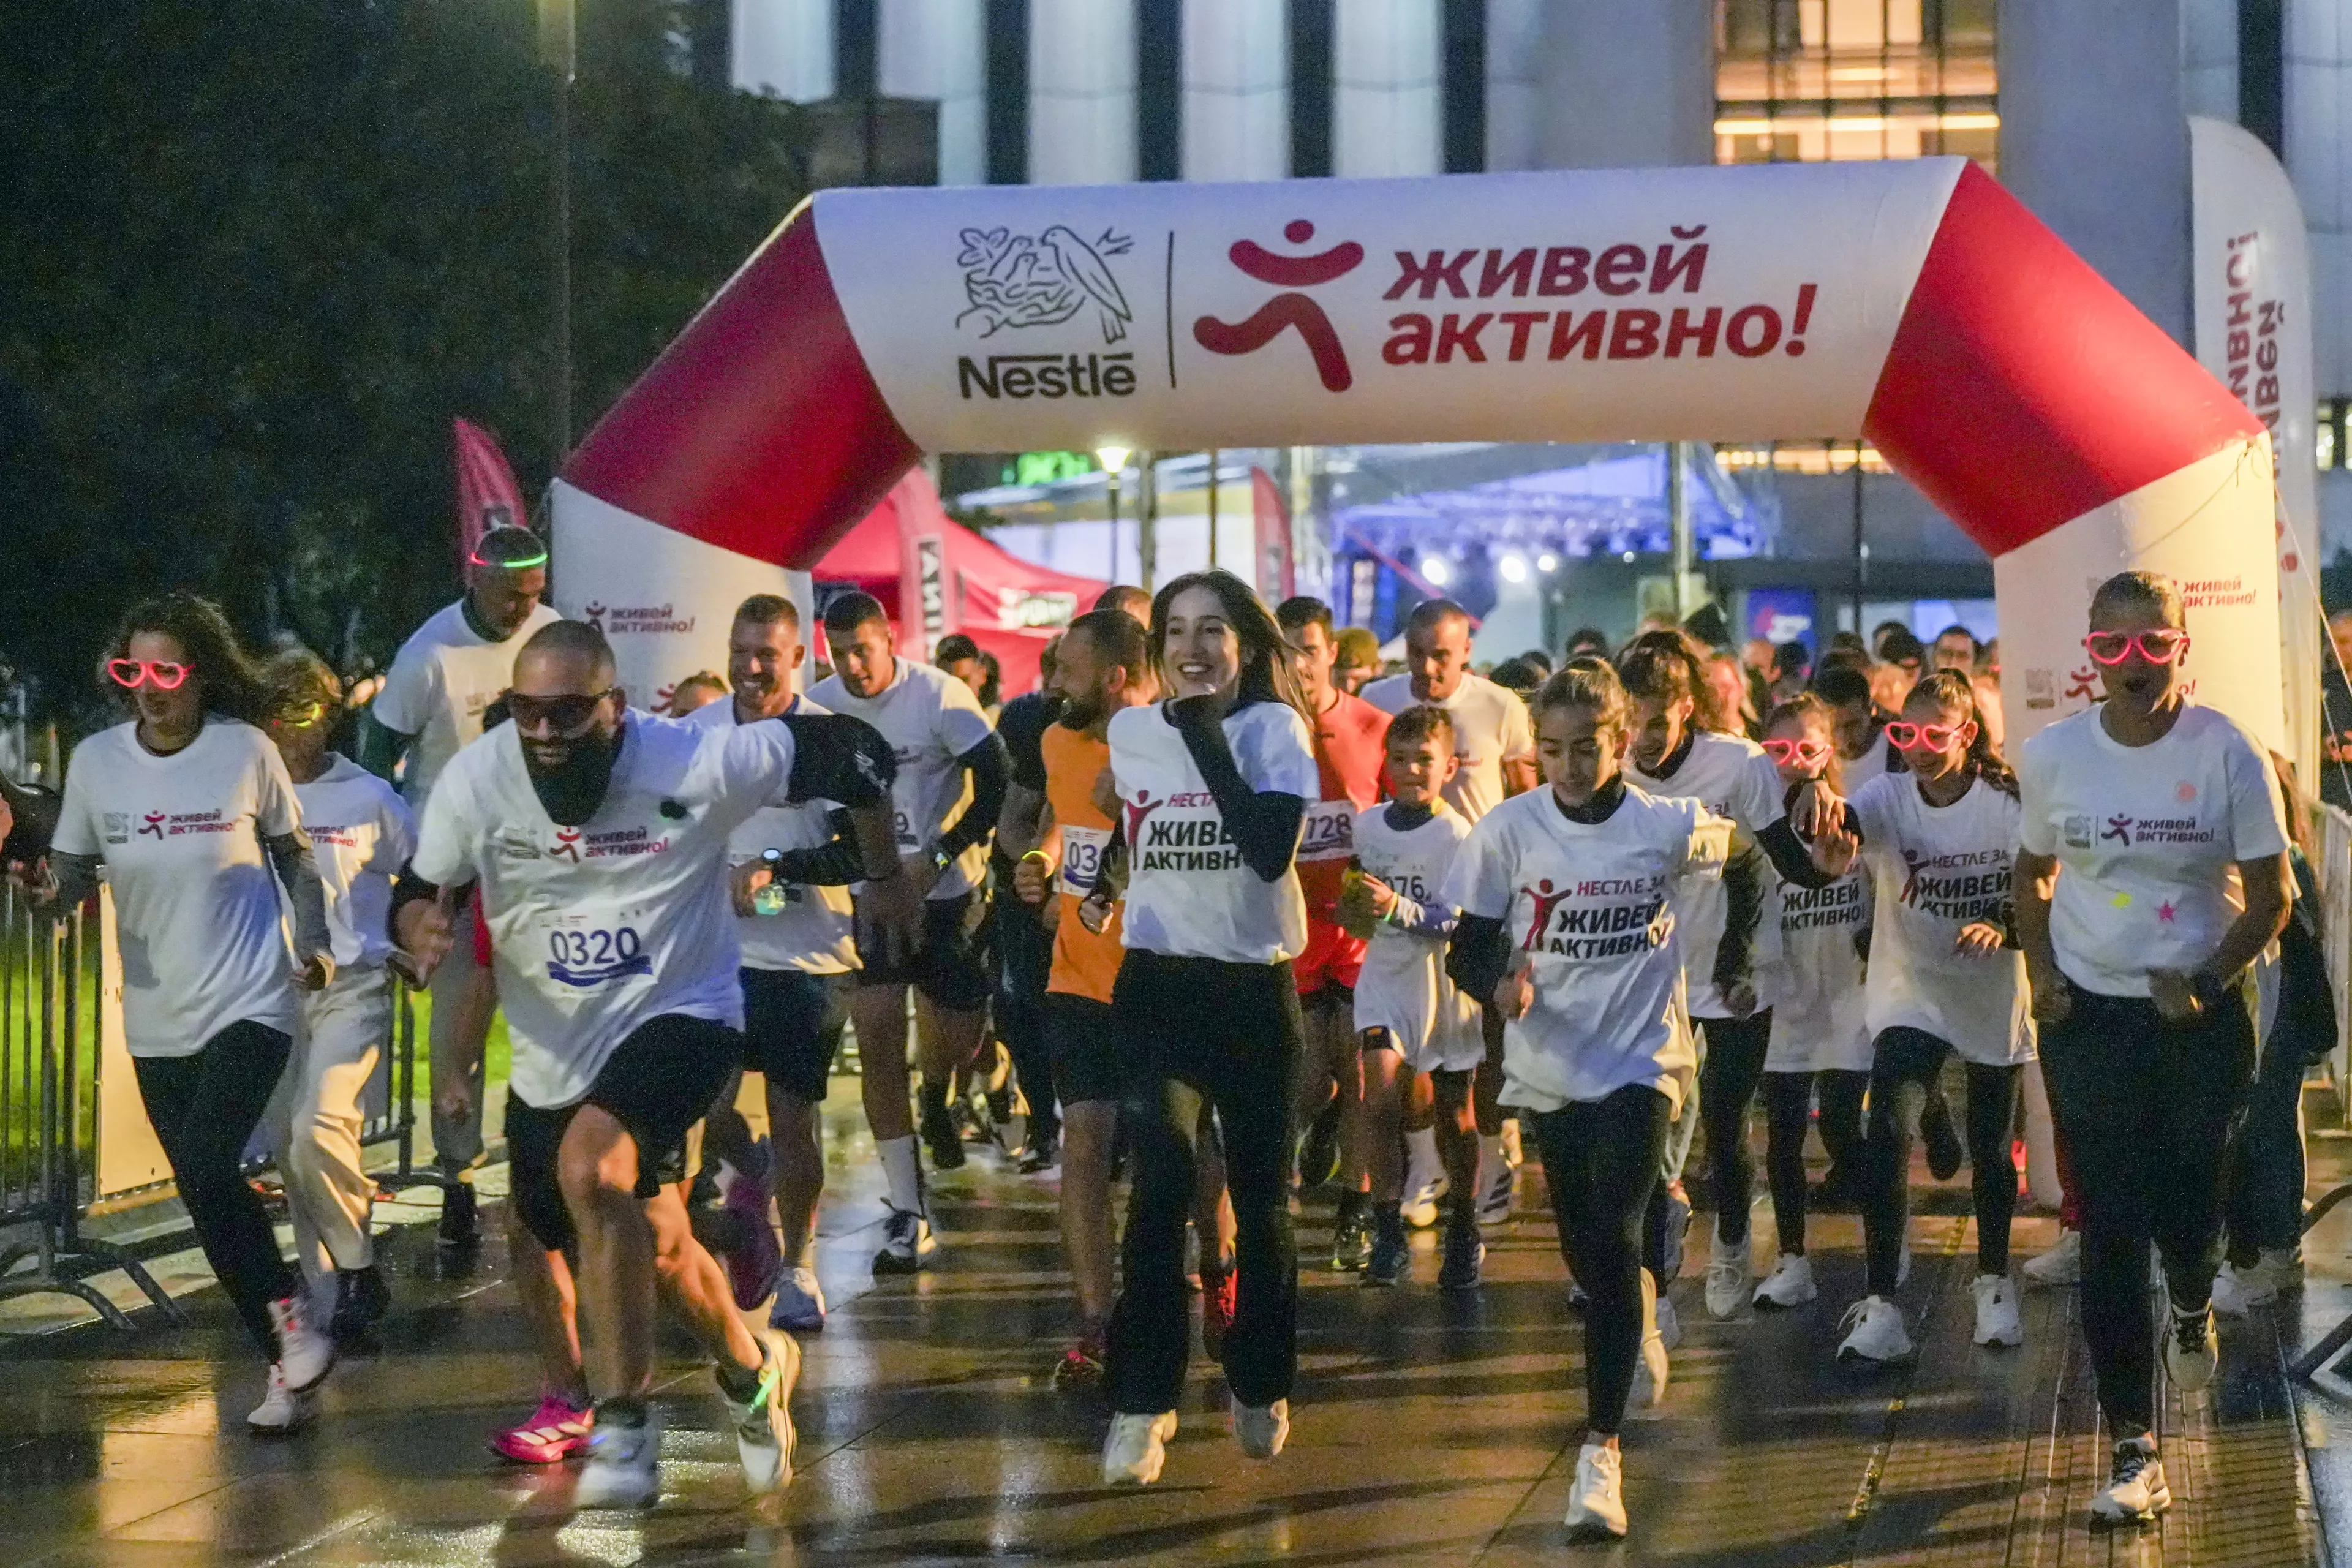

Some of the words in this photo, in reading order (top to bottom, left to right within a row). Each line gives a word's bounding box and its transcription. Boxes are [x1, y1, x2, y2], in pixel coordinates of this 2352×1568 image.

[1382, 224, 1711, 300] живей
[1382, 283, 1818, 366] активно!
[1167, 792, 1215, 807] НЕСТ
[1308, 813, 1352, 839] 728
[1069, 842, 1098, 872] 03
[1142, 850, 1241, 870] АКТИВН
[1577, 878, 1645, 896] НЕСТЛЕ
[1783, 878, 1860, 912] ЖИВЕЙ
[1920, 866, 2013, 899] ЖИВЕЙ
[1558, 892, 1664, 934] ЖИВЕЙ
[1781, 903, 1865, 934] АКТИВНО!
[551, 927, 641, 965] 0320
[1550, 921, 1670, 959] АКТИВНО!
